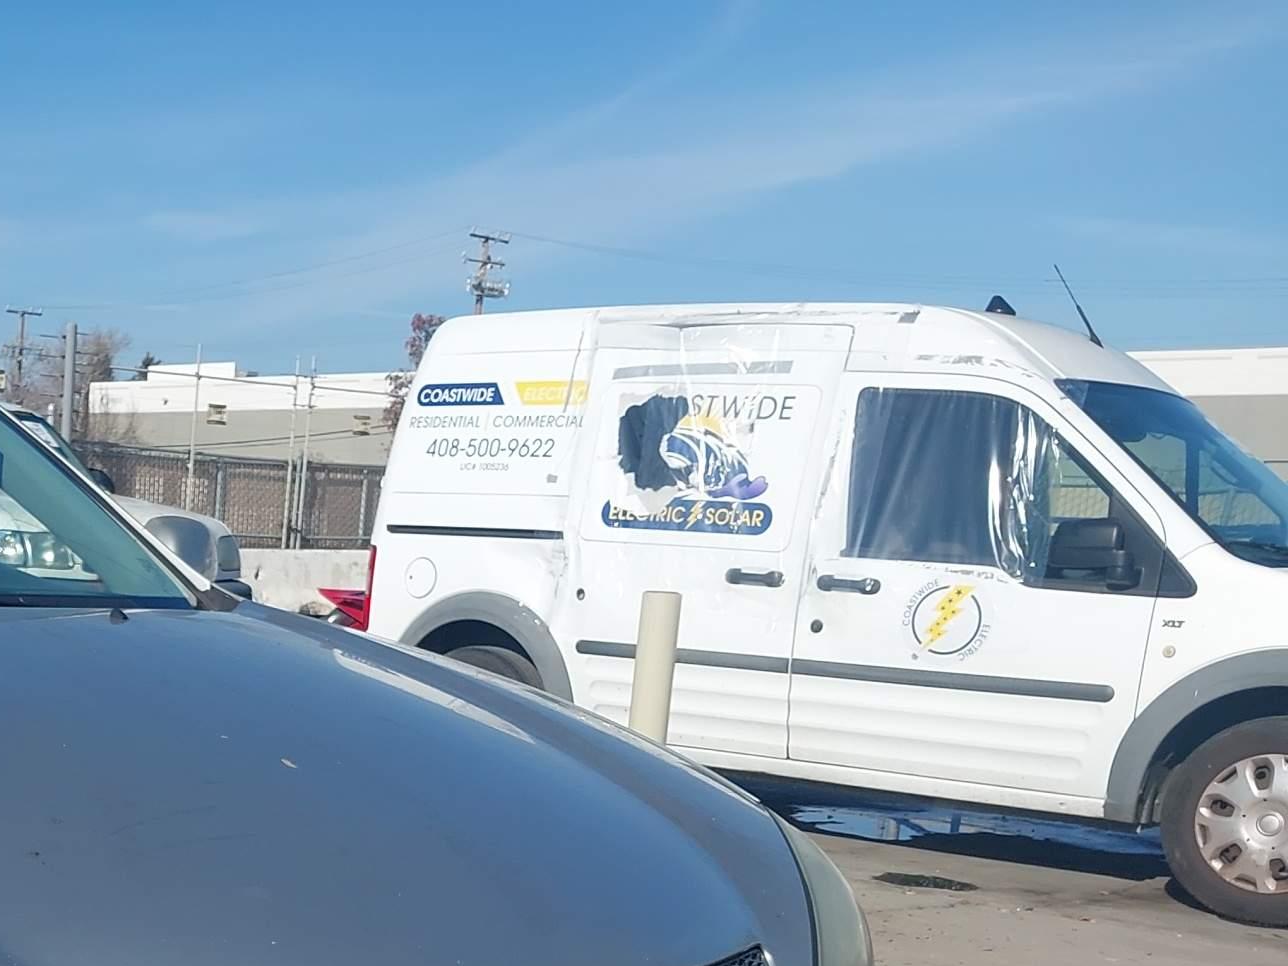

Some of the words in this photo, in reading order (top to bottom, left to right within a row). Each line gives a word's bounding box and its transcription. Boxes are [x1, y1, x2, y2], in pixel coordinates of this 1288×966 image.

[420, 386, 496, 403] COASTWIDE
[409, 415, 481, 429] RESIDENTIAL
[493, 414, 585, 428] COMMERCIAL
[426, 438, 555, 458] 408-500-9622
[705, 507, 765, 528] SOLAR
[902, 578, 941, 626] COASTWIDE
[957, 623, 991, 661] ELECTRIC
